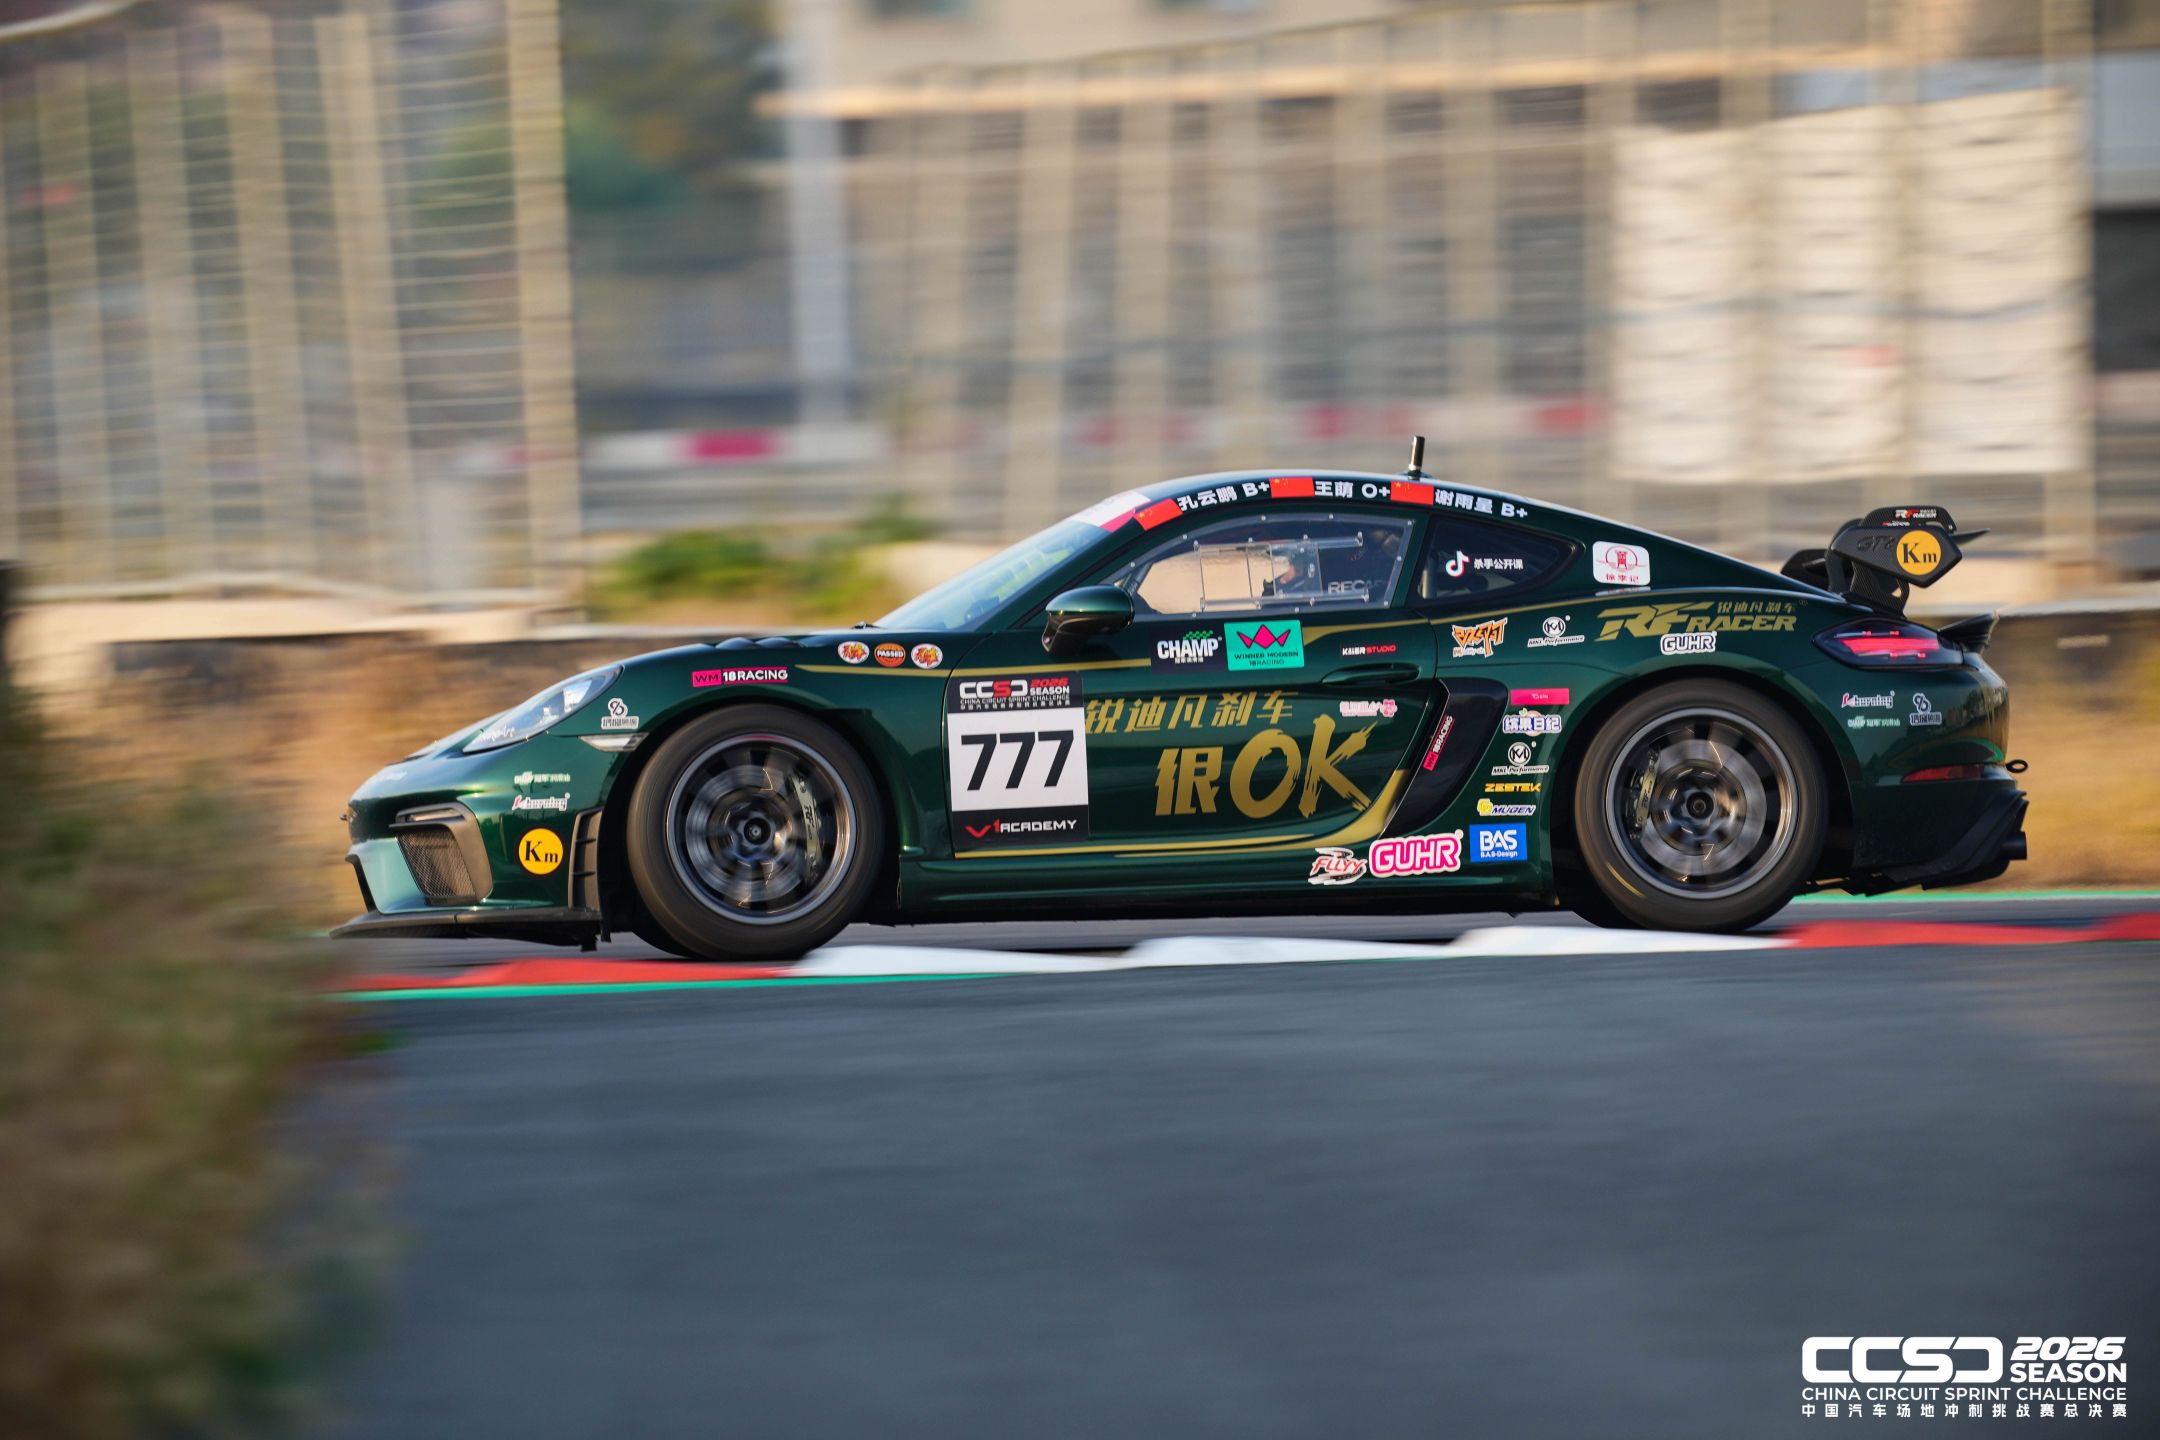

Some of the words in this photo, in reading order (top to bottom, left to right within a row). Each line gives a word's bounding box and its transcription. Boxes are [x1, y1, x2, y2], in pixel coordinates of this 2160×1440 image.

[1241, 482, 1270, 498] B+
[1361, 485, 1391, 499] O+
[1500, 502, 1529, 519] B+
[1902, 543, 1937, 563] Km
[1157, 637, 1219, 659] CHAMP
[1662, 637, 1714, 651] GUHR
[876, 649, 905, 659] PASSED
[1234, 652, 1265, 660] WINNER
[1267, 650, 1299, 658] MODERN
[1030, 686, 1070, 696] SEASON
[961, 730, 1074, 791] 777
[1492, 806, 1534, 815] MUGEN
[1480, 830, 1518, 851] BAS
[525, 841, 558, 863] Km
[1371, 837, 1459, 873] GUHR
